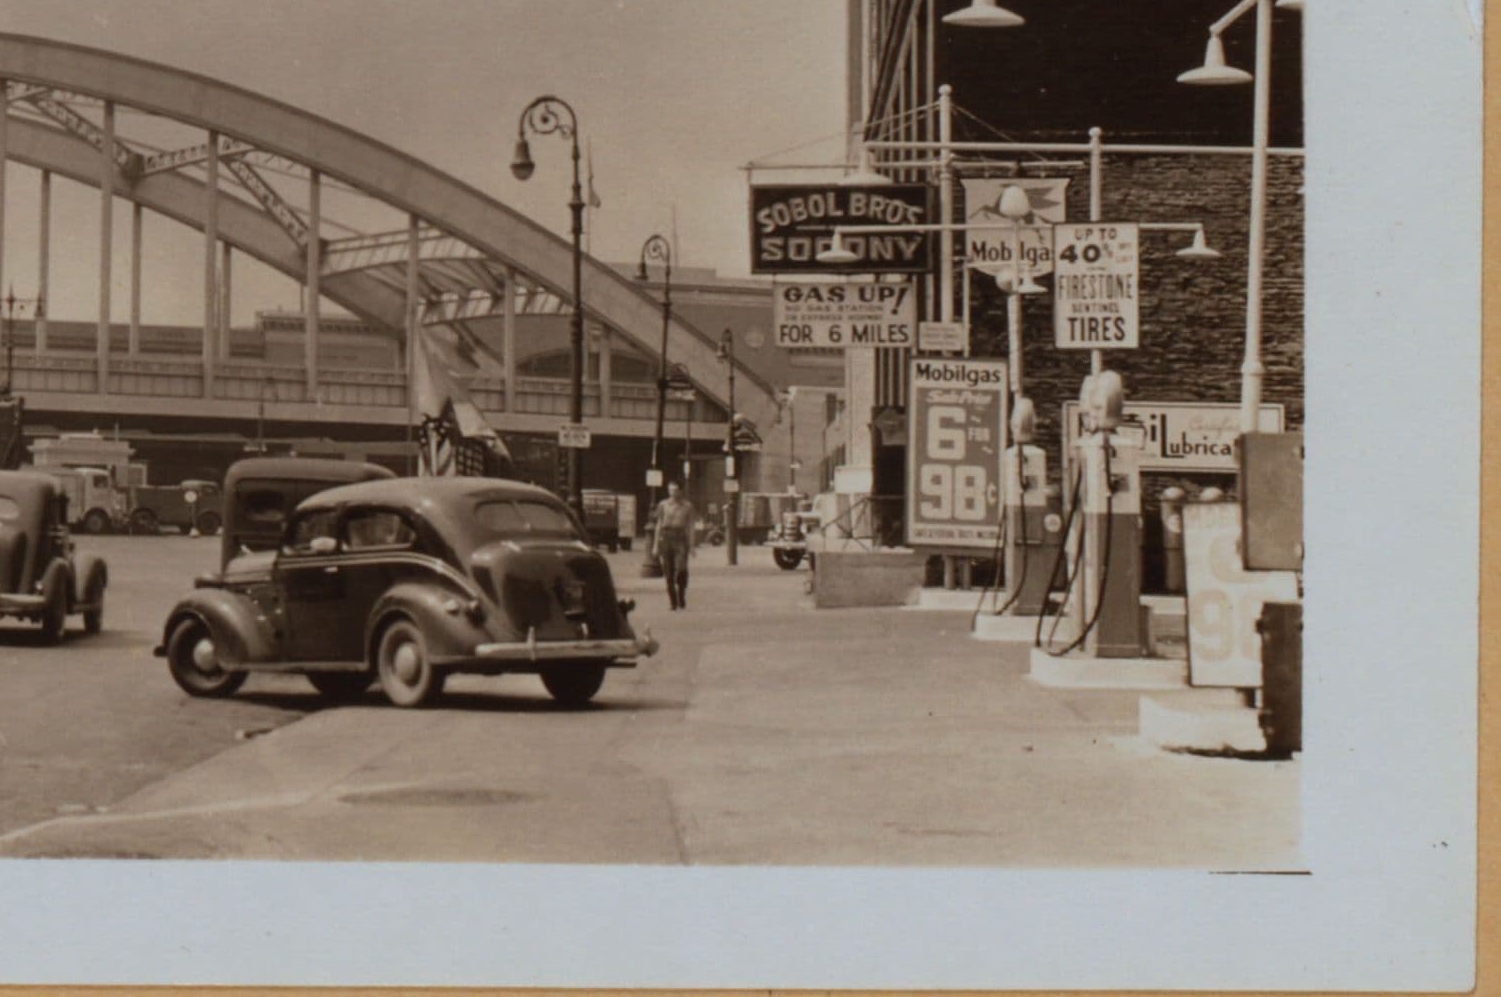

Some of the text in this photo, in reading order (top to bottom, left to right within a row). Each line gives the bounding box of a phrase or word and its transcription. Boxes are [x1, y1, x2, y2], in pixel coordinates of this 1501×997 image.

[757, 191, 844, 233] SOBOL
[1075, 228, 1117, 240] UP TO
[972, 241, 1053, 267] Moblga
[1058, 274, 1133, 299] FIRESTONE
[784, 286, 908, 315] GAS UP!
[780, 325, 813, 342] FOR
[828, 325, 842, 343] 6
[852, 325, 909, 343] MILES
[1067, 316, 1125, 341] TIRES
[916, 363, 1000, 386] Mobilgas
[927, 406, 967, 460] 6
